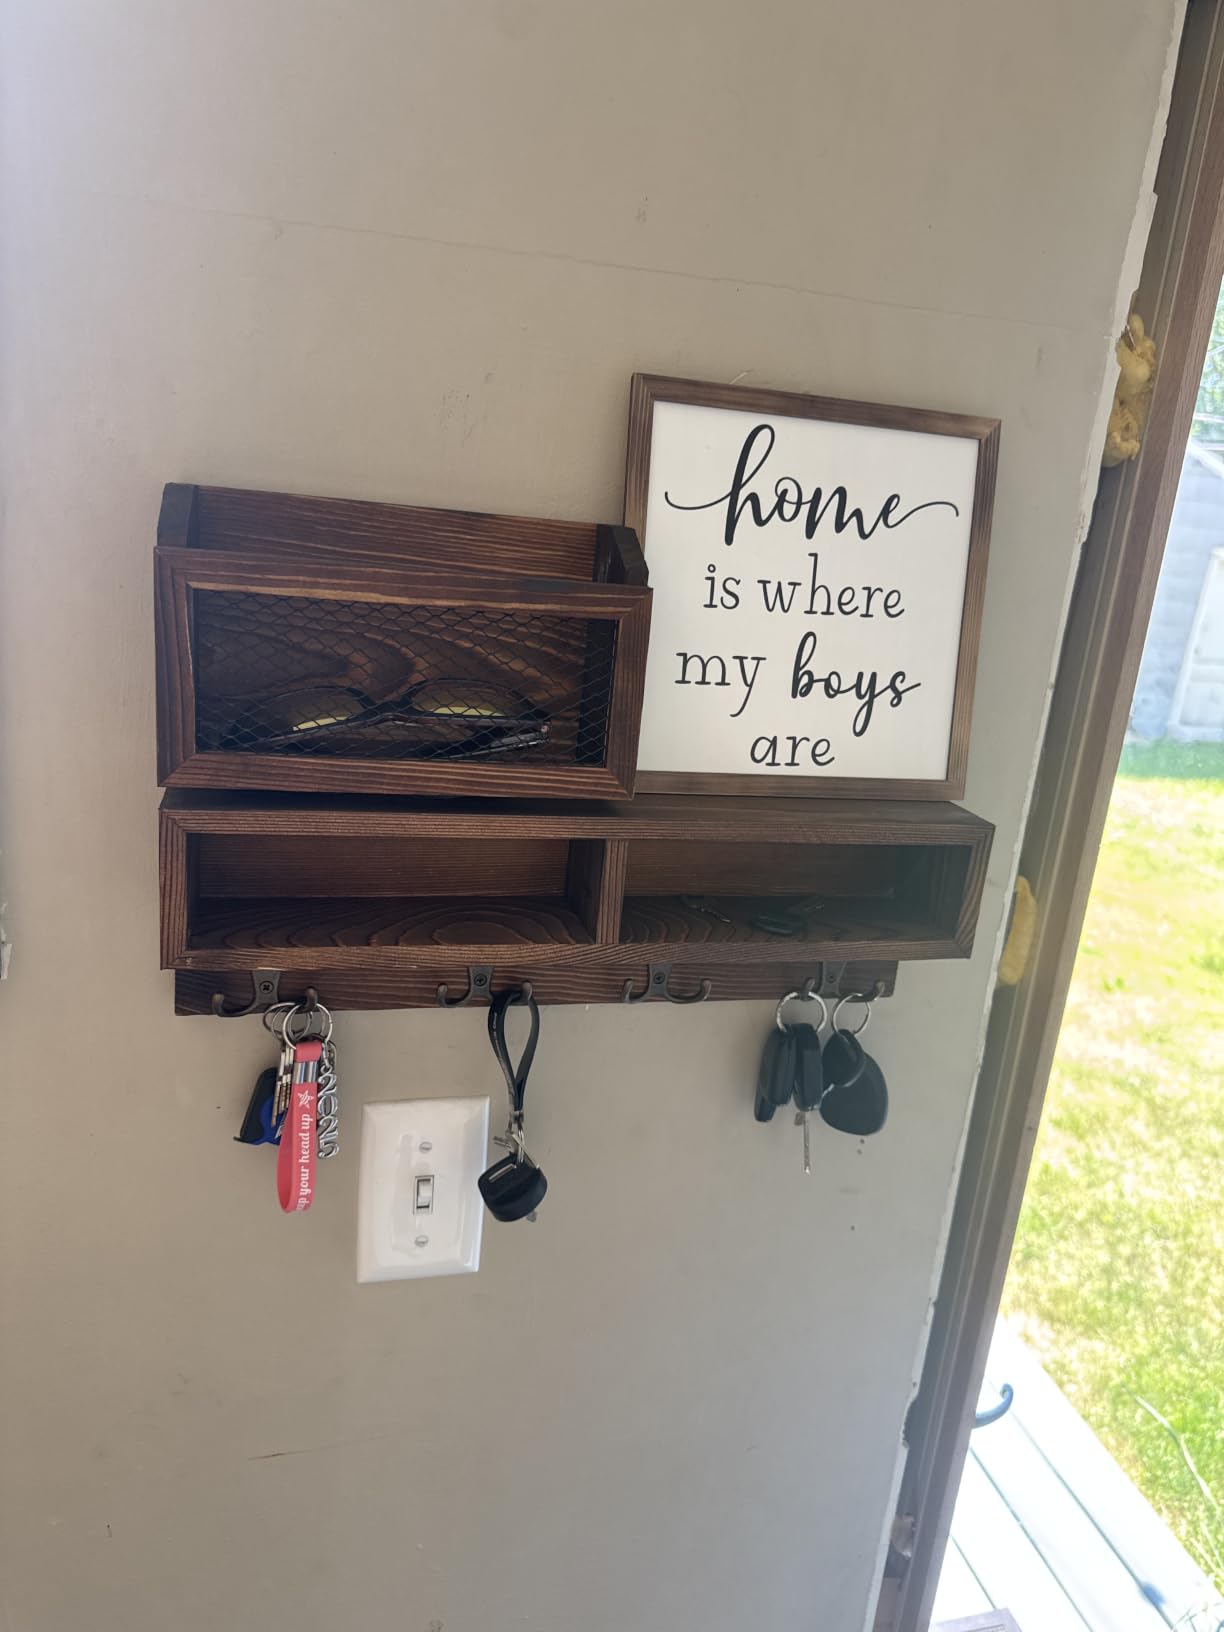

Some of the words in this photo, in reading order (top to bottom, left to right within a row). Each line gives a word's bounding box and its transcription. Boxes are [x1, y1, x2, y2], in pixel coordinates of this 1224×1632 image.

[665, 424, 959, 546] home
[703, 564, 741, 610] is
[757, 553, 905, 619] where
[675, 652, 767, 718] my
[791, 631, 922, 738] boys
[750, 735, 836, 767] are
[301, 1113, 314, 1130] up
[317, 1073, 339, 1158] 2025
[298, 1132, 310, 1163] head
[299, 1165, 312, 1196] your
